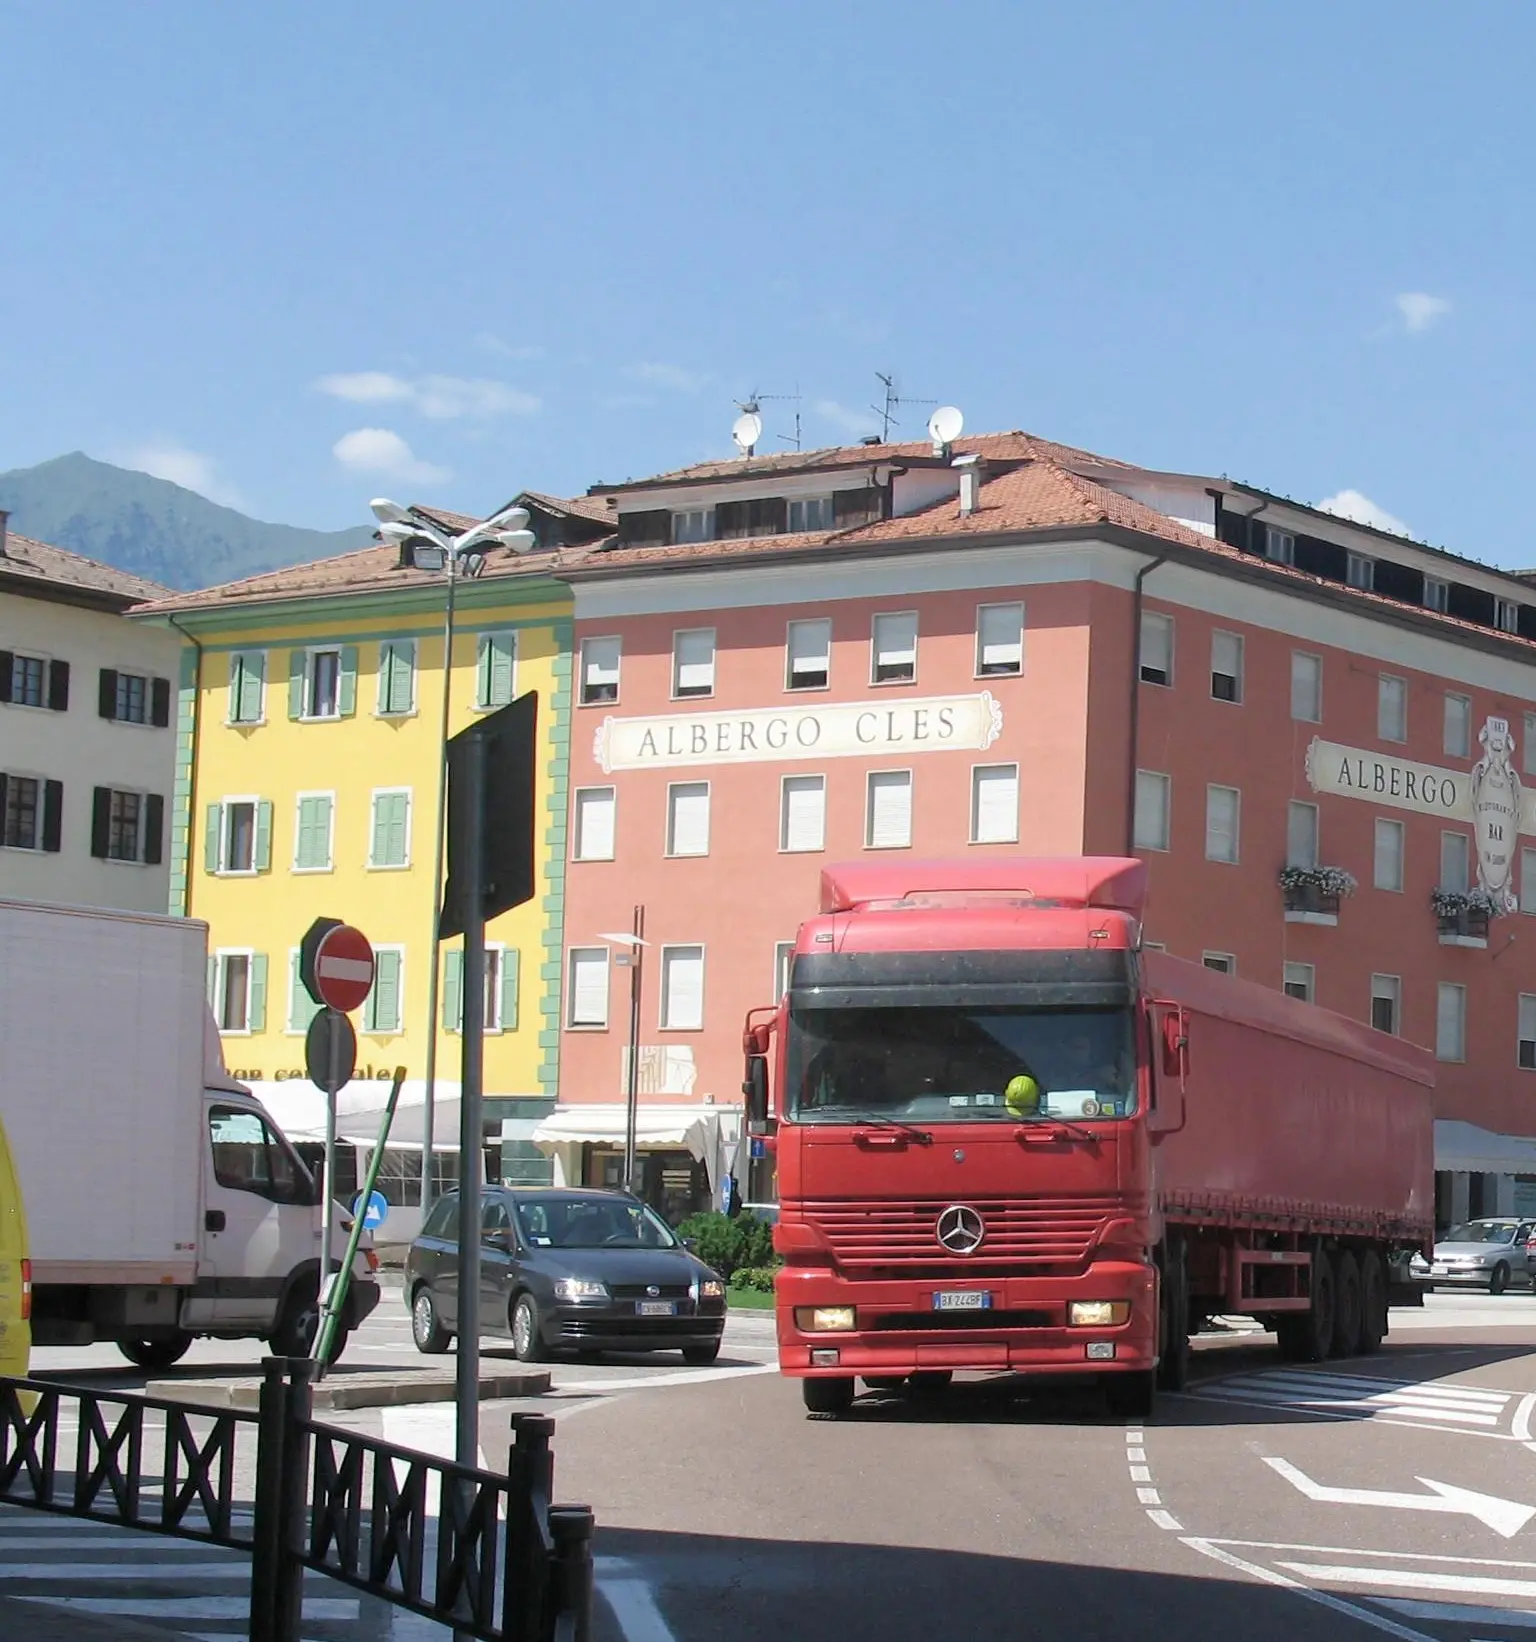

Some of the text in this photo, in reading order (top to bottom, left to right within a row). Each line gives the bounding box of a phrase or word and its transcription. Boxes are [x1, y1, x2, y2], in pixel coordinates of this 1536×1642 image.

[637, 707, 956, 757] ALBERGO CLES
[1338, 757, 1457, 808] ALBERGO
[1488, 822, 1504, 841] BAR
